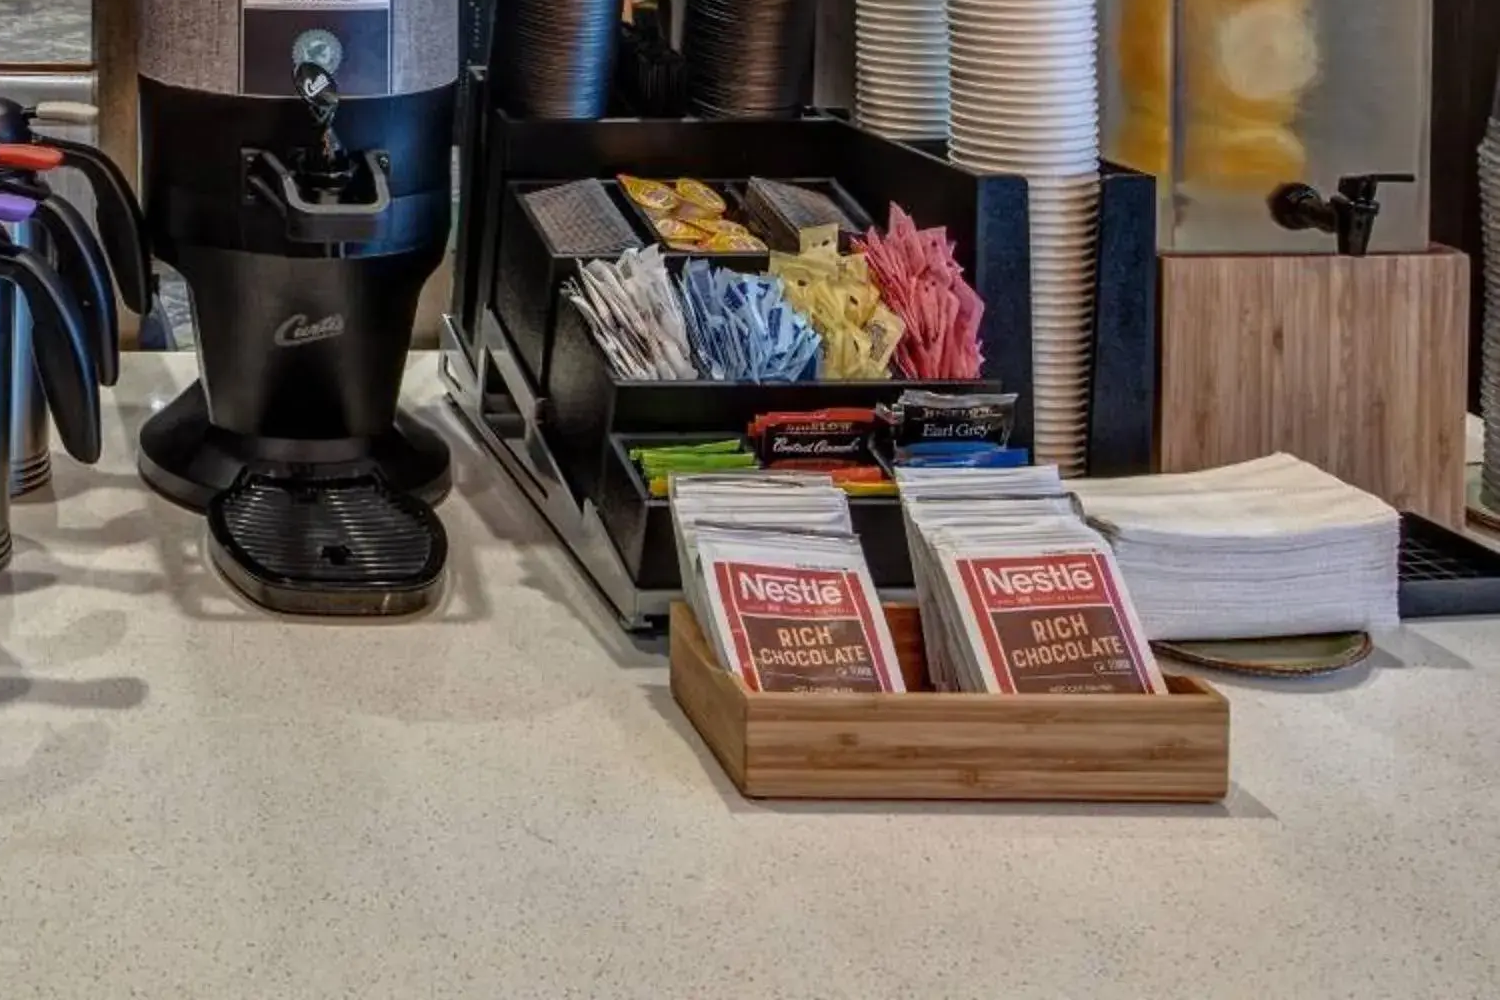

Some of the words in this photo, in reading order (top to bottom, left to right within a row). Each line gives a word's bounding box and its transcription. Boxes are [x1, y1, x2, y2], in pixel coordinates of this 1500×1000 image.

[923, 423, 954, 437] Earl
[956, 423, 989, 438] Grey
[777, 625, 834, 647] RICH
[1030, 612, 1089, 645] RICH
[759, 645, 869, 667] CHOCOLATE
[1010, 635, 1126, 669] CHOCOLATE
